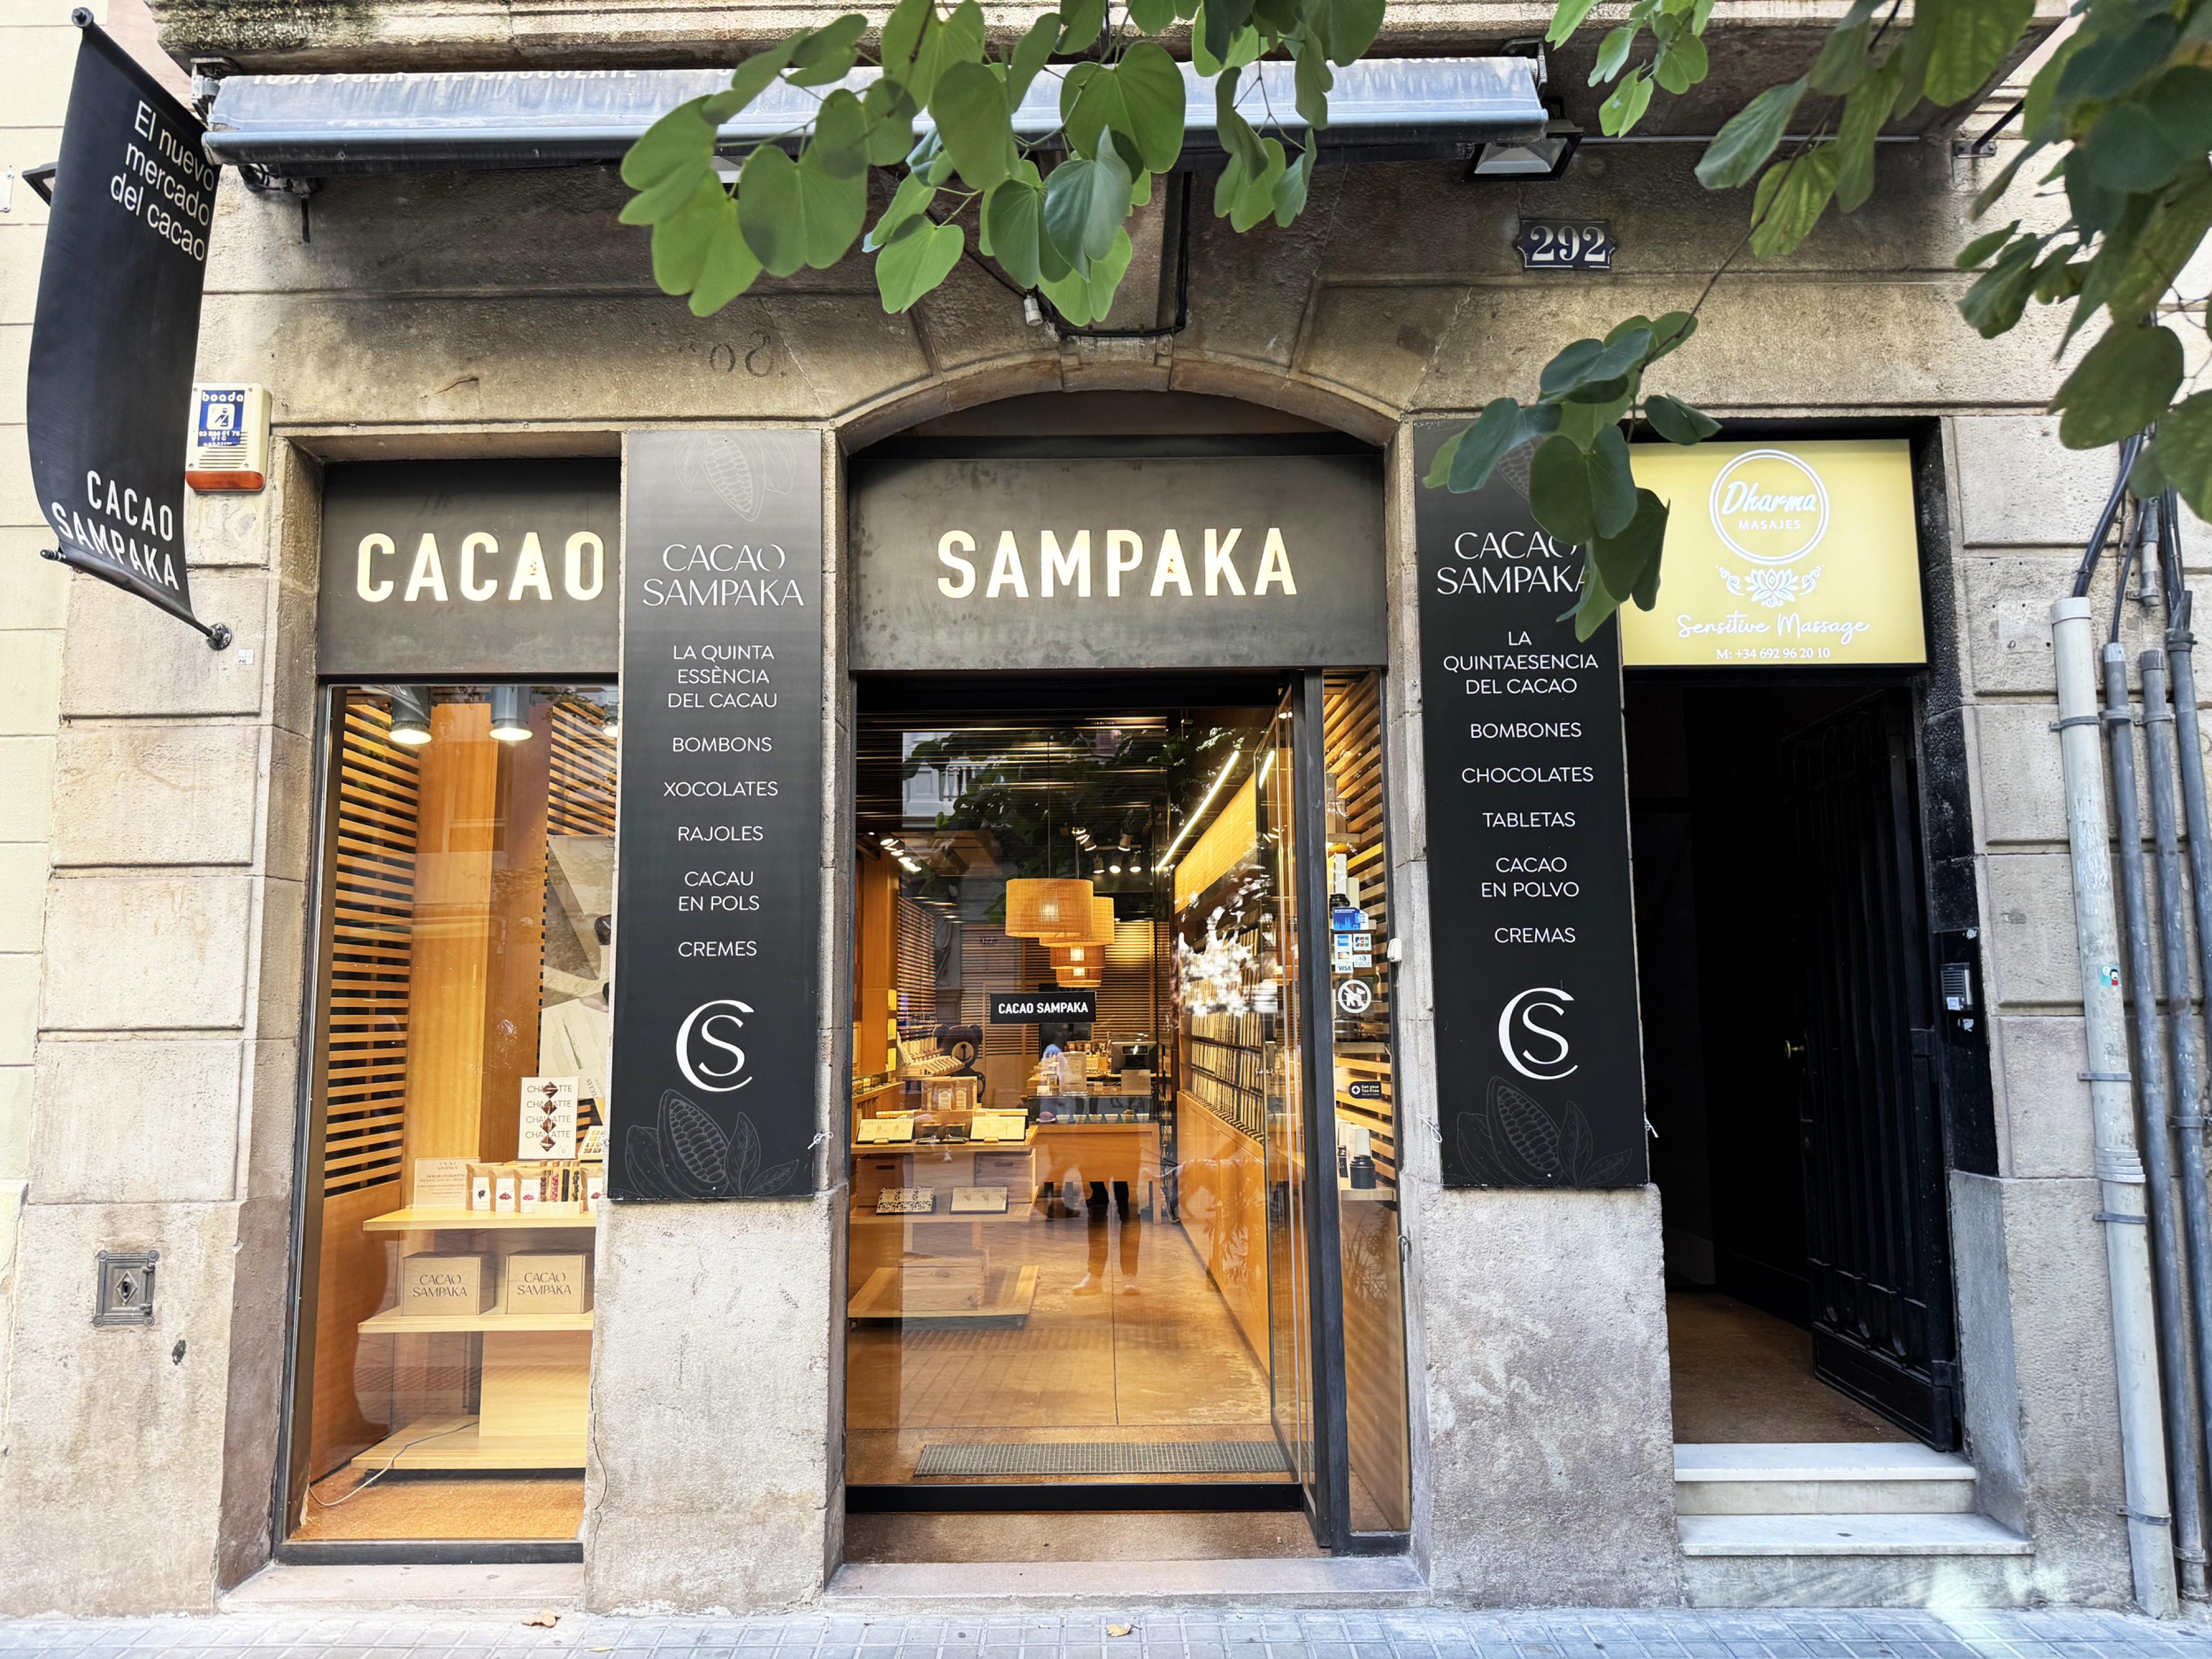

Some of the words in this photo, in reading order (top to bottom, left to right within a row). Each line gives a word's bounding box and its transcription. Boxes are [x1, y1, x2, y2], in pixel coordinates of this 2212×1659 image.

[134, 100, 156, 142] El
[158, 128, 215, 192] nuevo
[125, 143, 210, 226] mercado
[111, 173, 143, 217] del
[147, 202, 205, 262] cacao
[1530, 226, 1606, 262] 292
[202, 391, 244, 402] boada
[87, 470, 173, 541] CACAO
[1722, 480, 1816, 515] Dharma
[1738, 520, 1801, 530] MASAJES
[52, 502, 179, 590] SAMPAKA
[662, 544, 786, 572] CACAO
[937, 527, 1297, 599] SAMPAKA
[357, 531, 604, 603] CACAO
[642, 578, 804, 607] SAMPAKA
[1677, 610, 1771, 638] Sensitive
[1777, 612, 1870, 645] Massage
[1508, 631, 1532, 646] LA
[673, 645, 696, 660] LA
[702, 645, 775, 662] QUINTA
[1716, 649, 1732, 660] M:
[1735, 648, 1757, 659] +34
[1760, 648, 1780, 658] 692
[1782, 647, 1797, 658] 96
[1800, 647, 1814, 658] 20
[1817, 647, 1830, 658] 10
[1443, 653, 1599, 672] QUINTAESENCIA
[677, 665, 770, 684] ESSÈNCIA
[1465, 679, 1502, 694] DEL
[1506, 678, 1577, 694] CACAO
[668, 693, 704, 708] DEL
[709, 693, 778, 708] CACAU
[1470, 722, 1582, 738] BOMBONES
[673, 737, 772, 752] BOMBONS
[1461, 767, 1594, 783] CHOCOLATES
[664, 781, 778, 797] XOCOLATES
[1482, 812, 1576, 828] TABLETAS
[678, 826, 763, 841] RAJOLES
[1495, 857, 1567, 873] CACAO
[684, 871, 754, 887] CACAU
[1481, 882, 1506, 897] EN
[1513, 881, 1580, 897] POLVO
[679, 896, 703, 911] EN
[711, 895, 760, 911] POLS
[1494, 927, 1576, 944] CREMAS
[678, 941, 757, 957] CREMES
[998, 1003, 1034, 1014] CACAO
[1036, 1002, 1089, 1014] SAMPAKA
[1498, 987, 1578, 1080] CS
[676, 999, 755, 1092] CS
[419, 1274, 461, 1285] CACAO
[524, 1272, 566, 1283] CACAO
[412, 1286, 467, 1297] SAMPAKA
[517, 1285, 571, 1295] SAMPAKA
